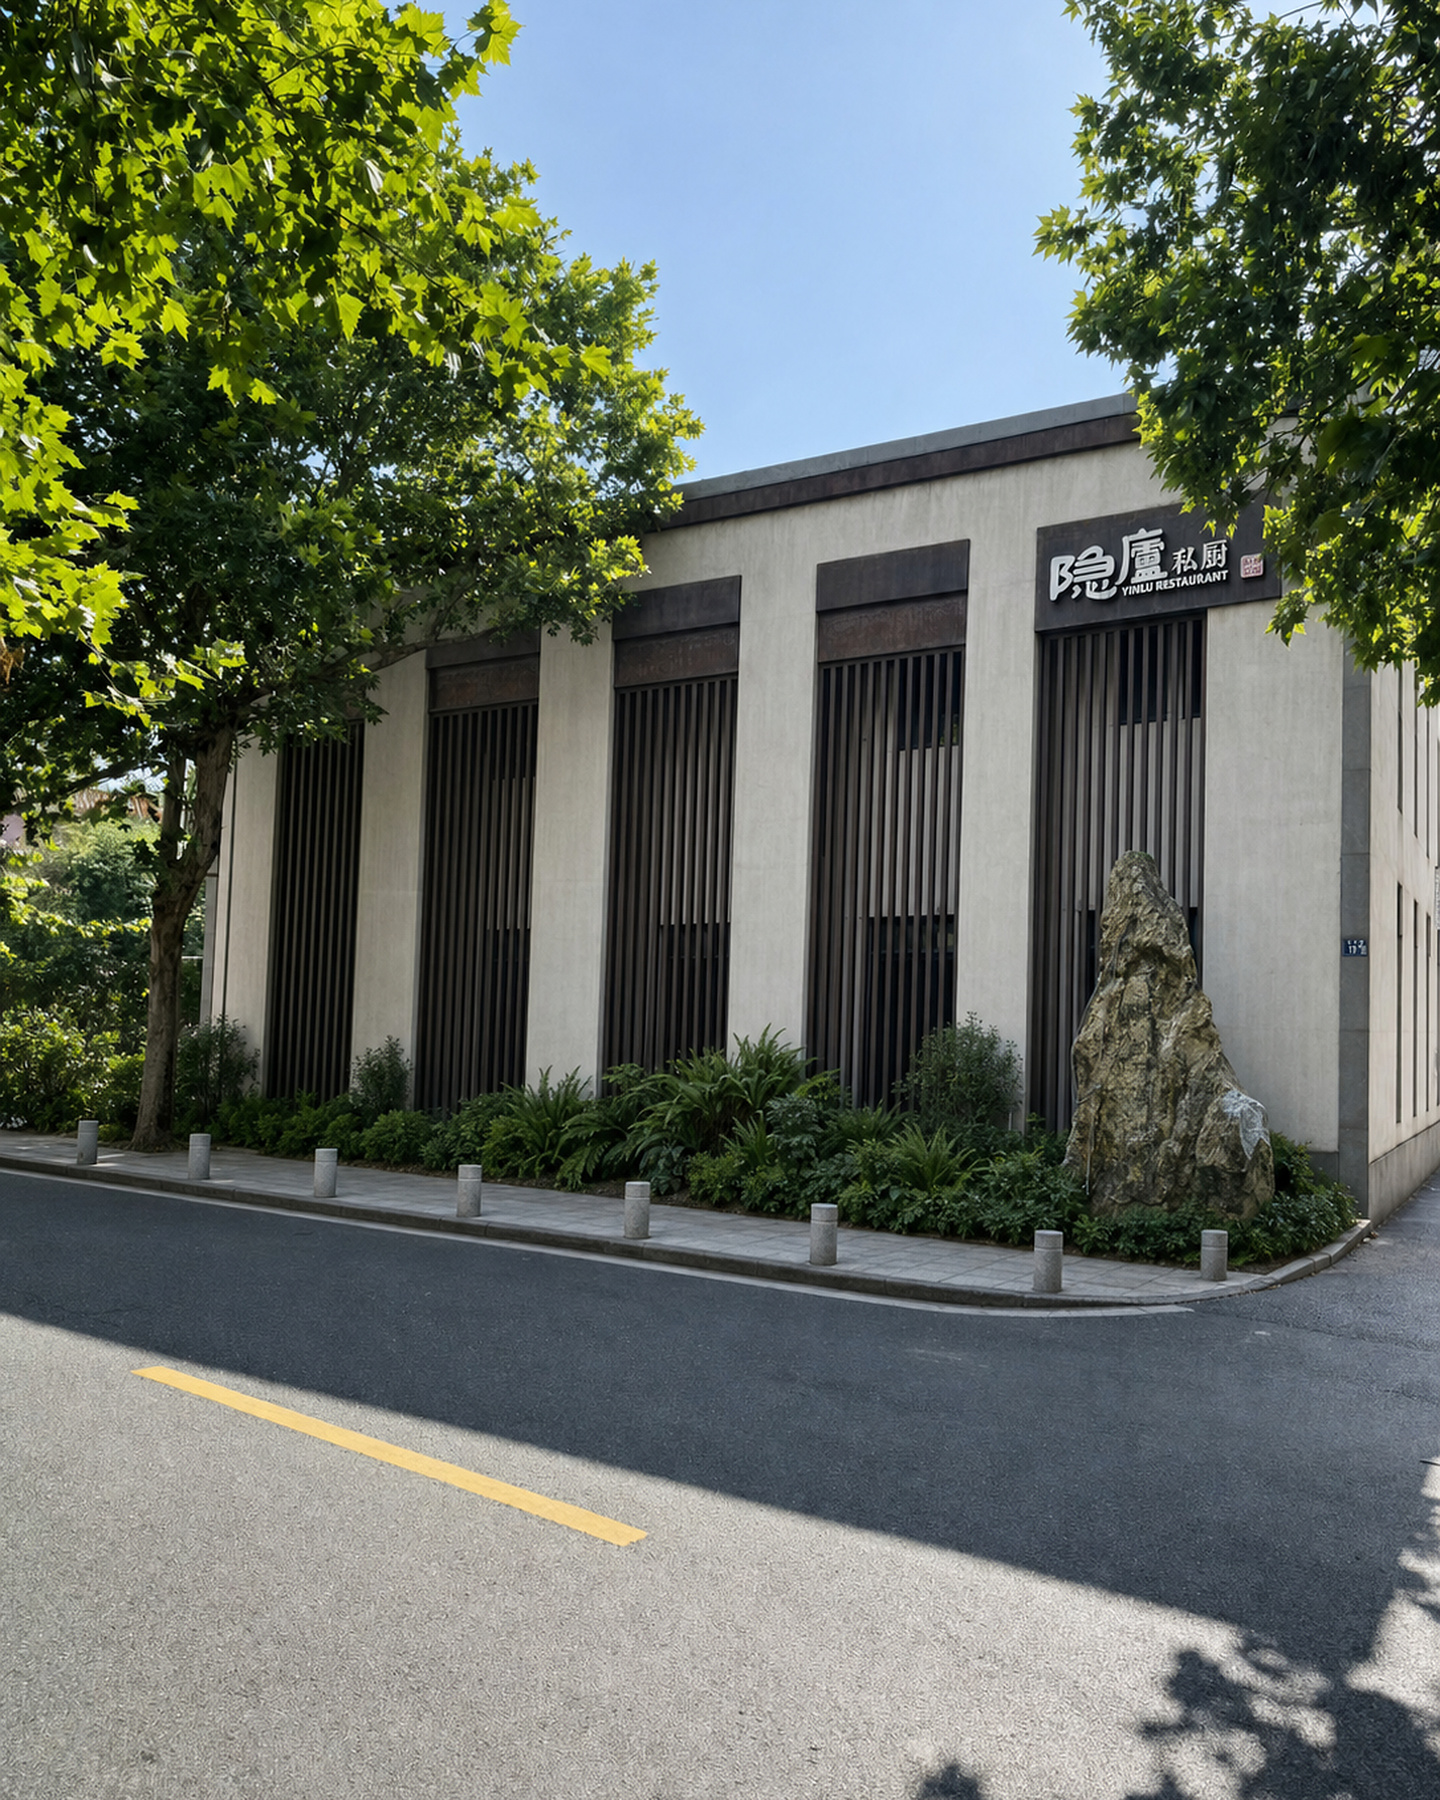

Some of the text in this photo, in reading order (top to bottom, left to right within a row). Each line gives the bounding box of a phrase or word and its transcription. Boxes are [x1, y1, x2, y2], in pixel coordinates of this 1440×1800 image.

[1171, 539, 1228, 575] 私厨
[1121, 569, 1229, 597] YINLU RESTAURANT
